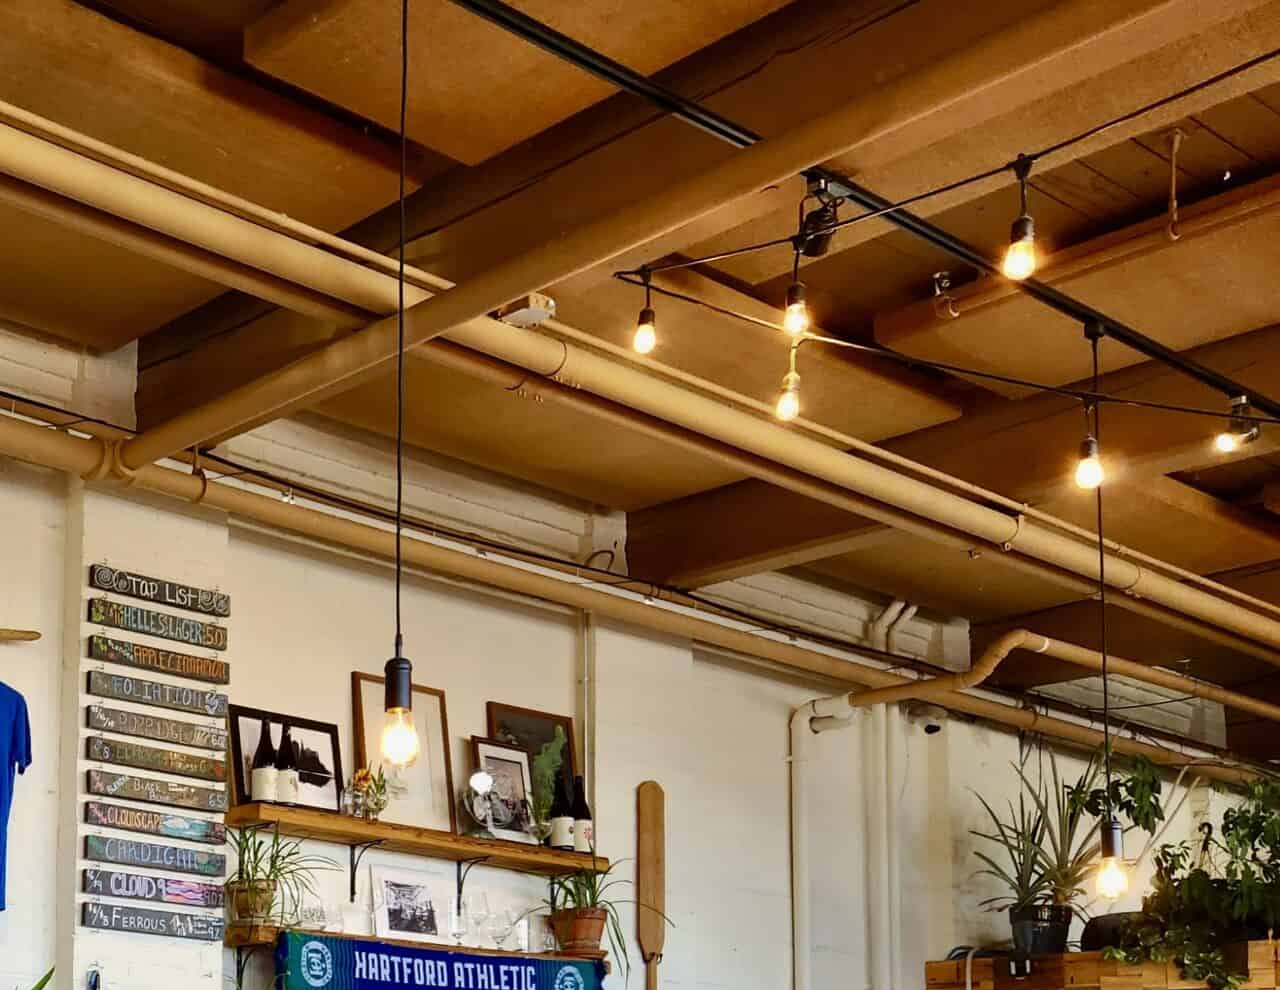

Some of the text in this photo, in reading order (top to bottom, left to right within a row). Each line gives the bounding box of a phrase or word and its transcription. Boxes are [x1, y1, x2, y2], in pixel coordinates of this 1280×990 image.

[169, 616, 202, 644] LAGER
[110, 872, 155, 898] CLOUD
[353, 950, 449, 988] HARTFORD
